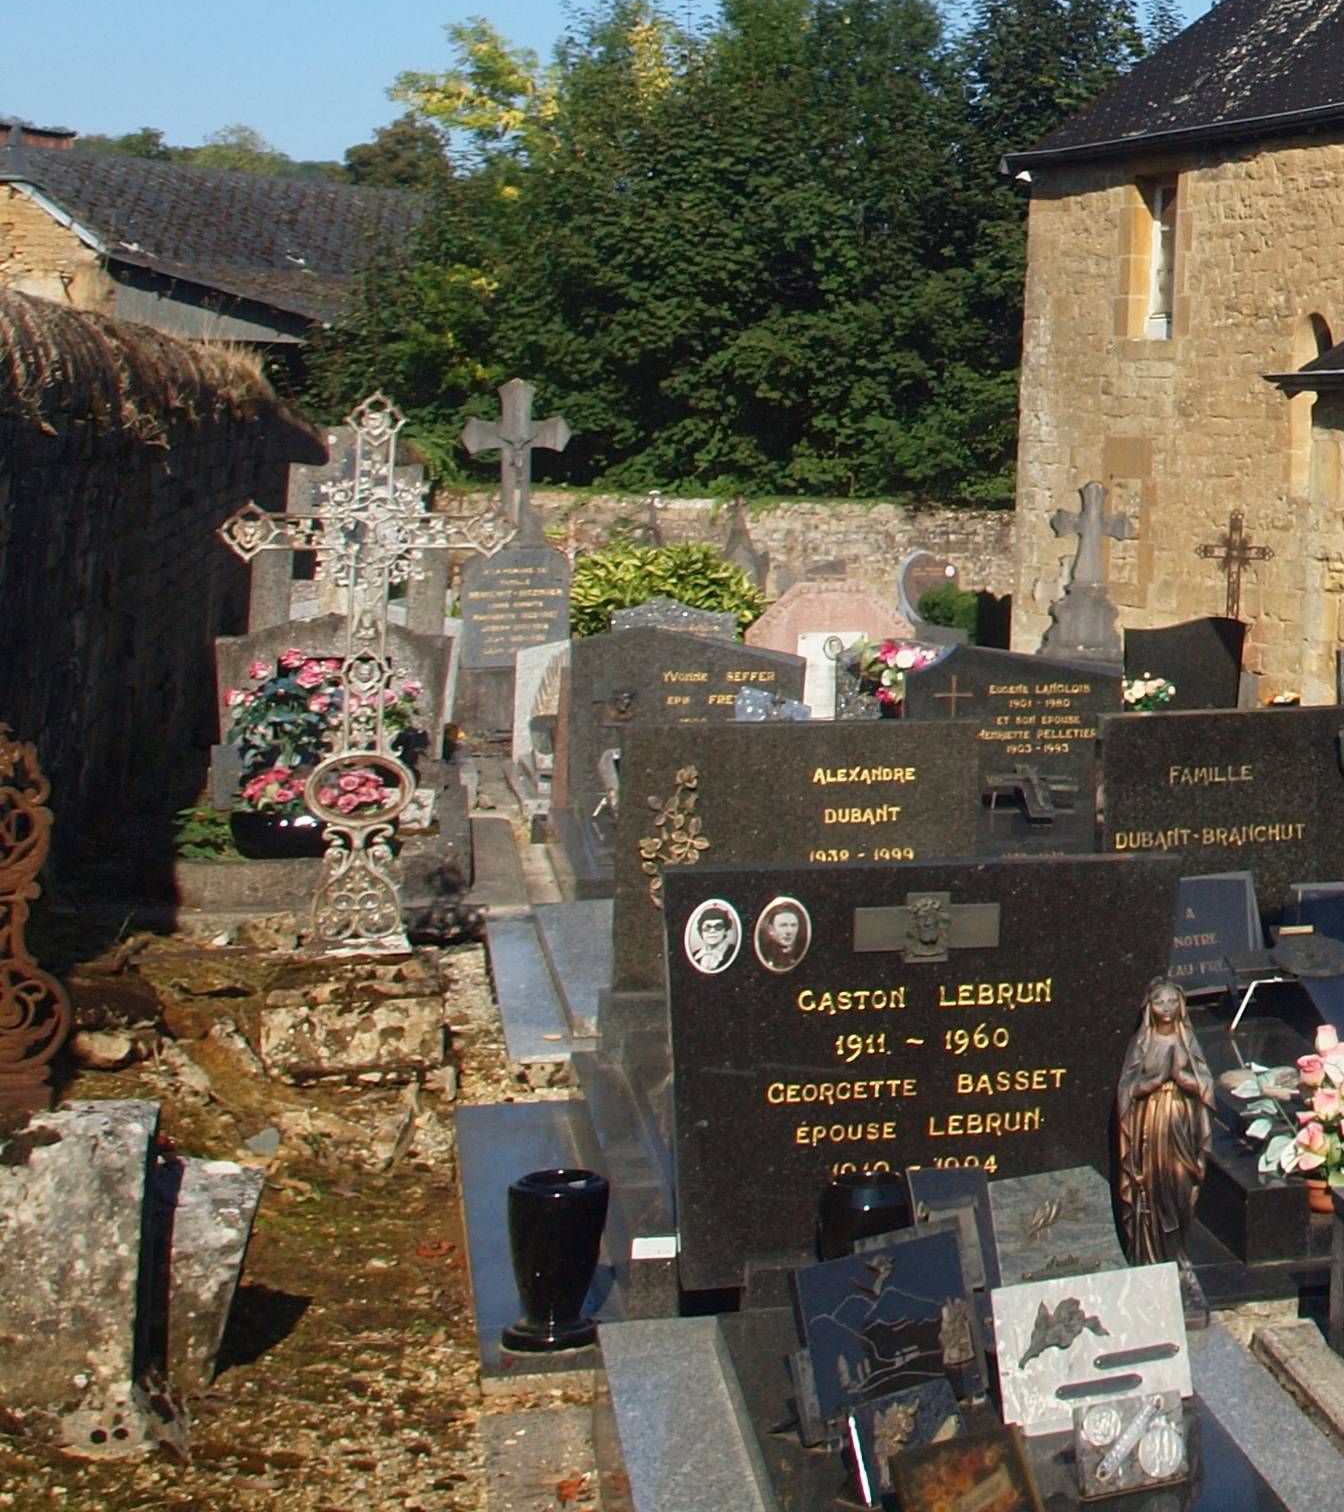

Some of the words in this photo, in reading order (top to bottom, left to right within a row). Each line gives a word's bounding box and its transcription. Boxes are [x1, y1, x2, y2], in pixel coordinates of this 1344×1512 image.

[812, 766, 916, 785] ALEXANDRE
[1169, 765, 1253, 785] FAMILLE
[823, 804, 902, 826] DUBANT
[874, 847, 915, 862] 1999
[798, 987, 906, 1016] GASTON
[939, 978, 1053, 1010] LEBRUN
[835, 1033, 888, 1063] 1911
[944, 1023, 1010, 1055] 1960
[767, 1079, 918, 1106] GEORGETTE
[957, 1068, 1068, 1097] BASSET
[928, 1107, 1041, 1137] LEBRUN
